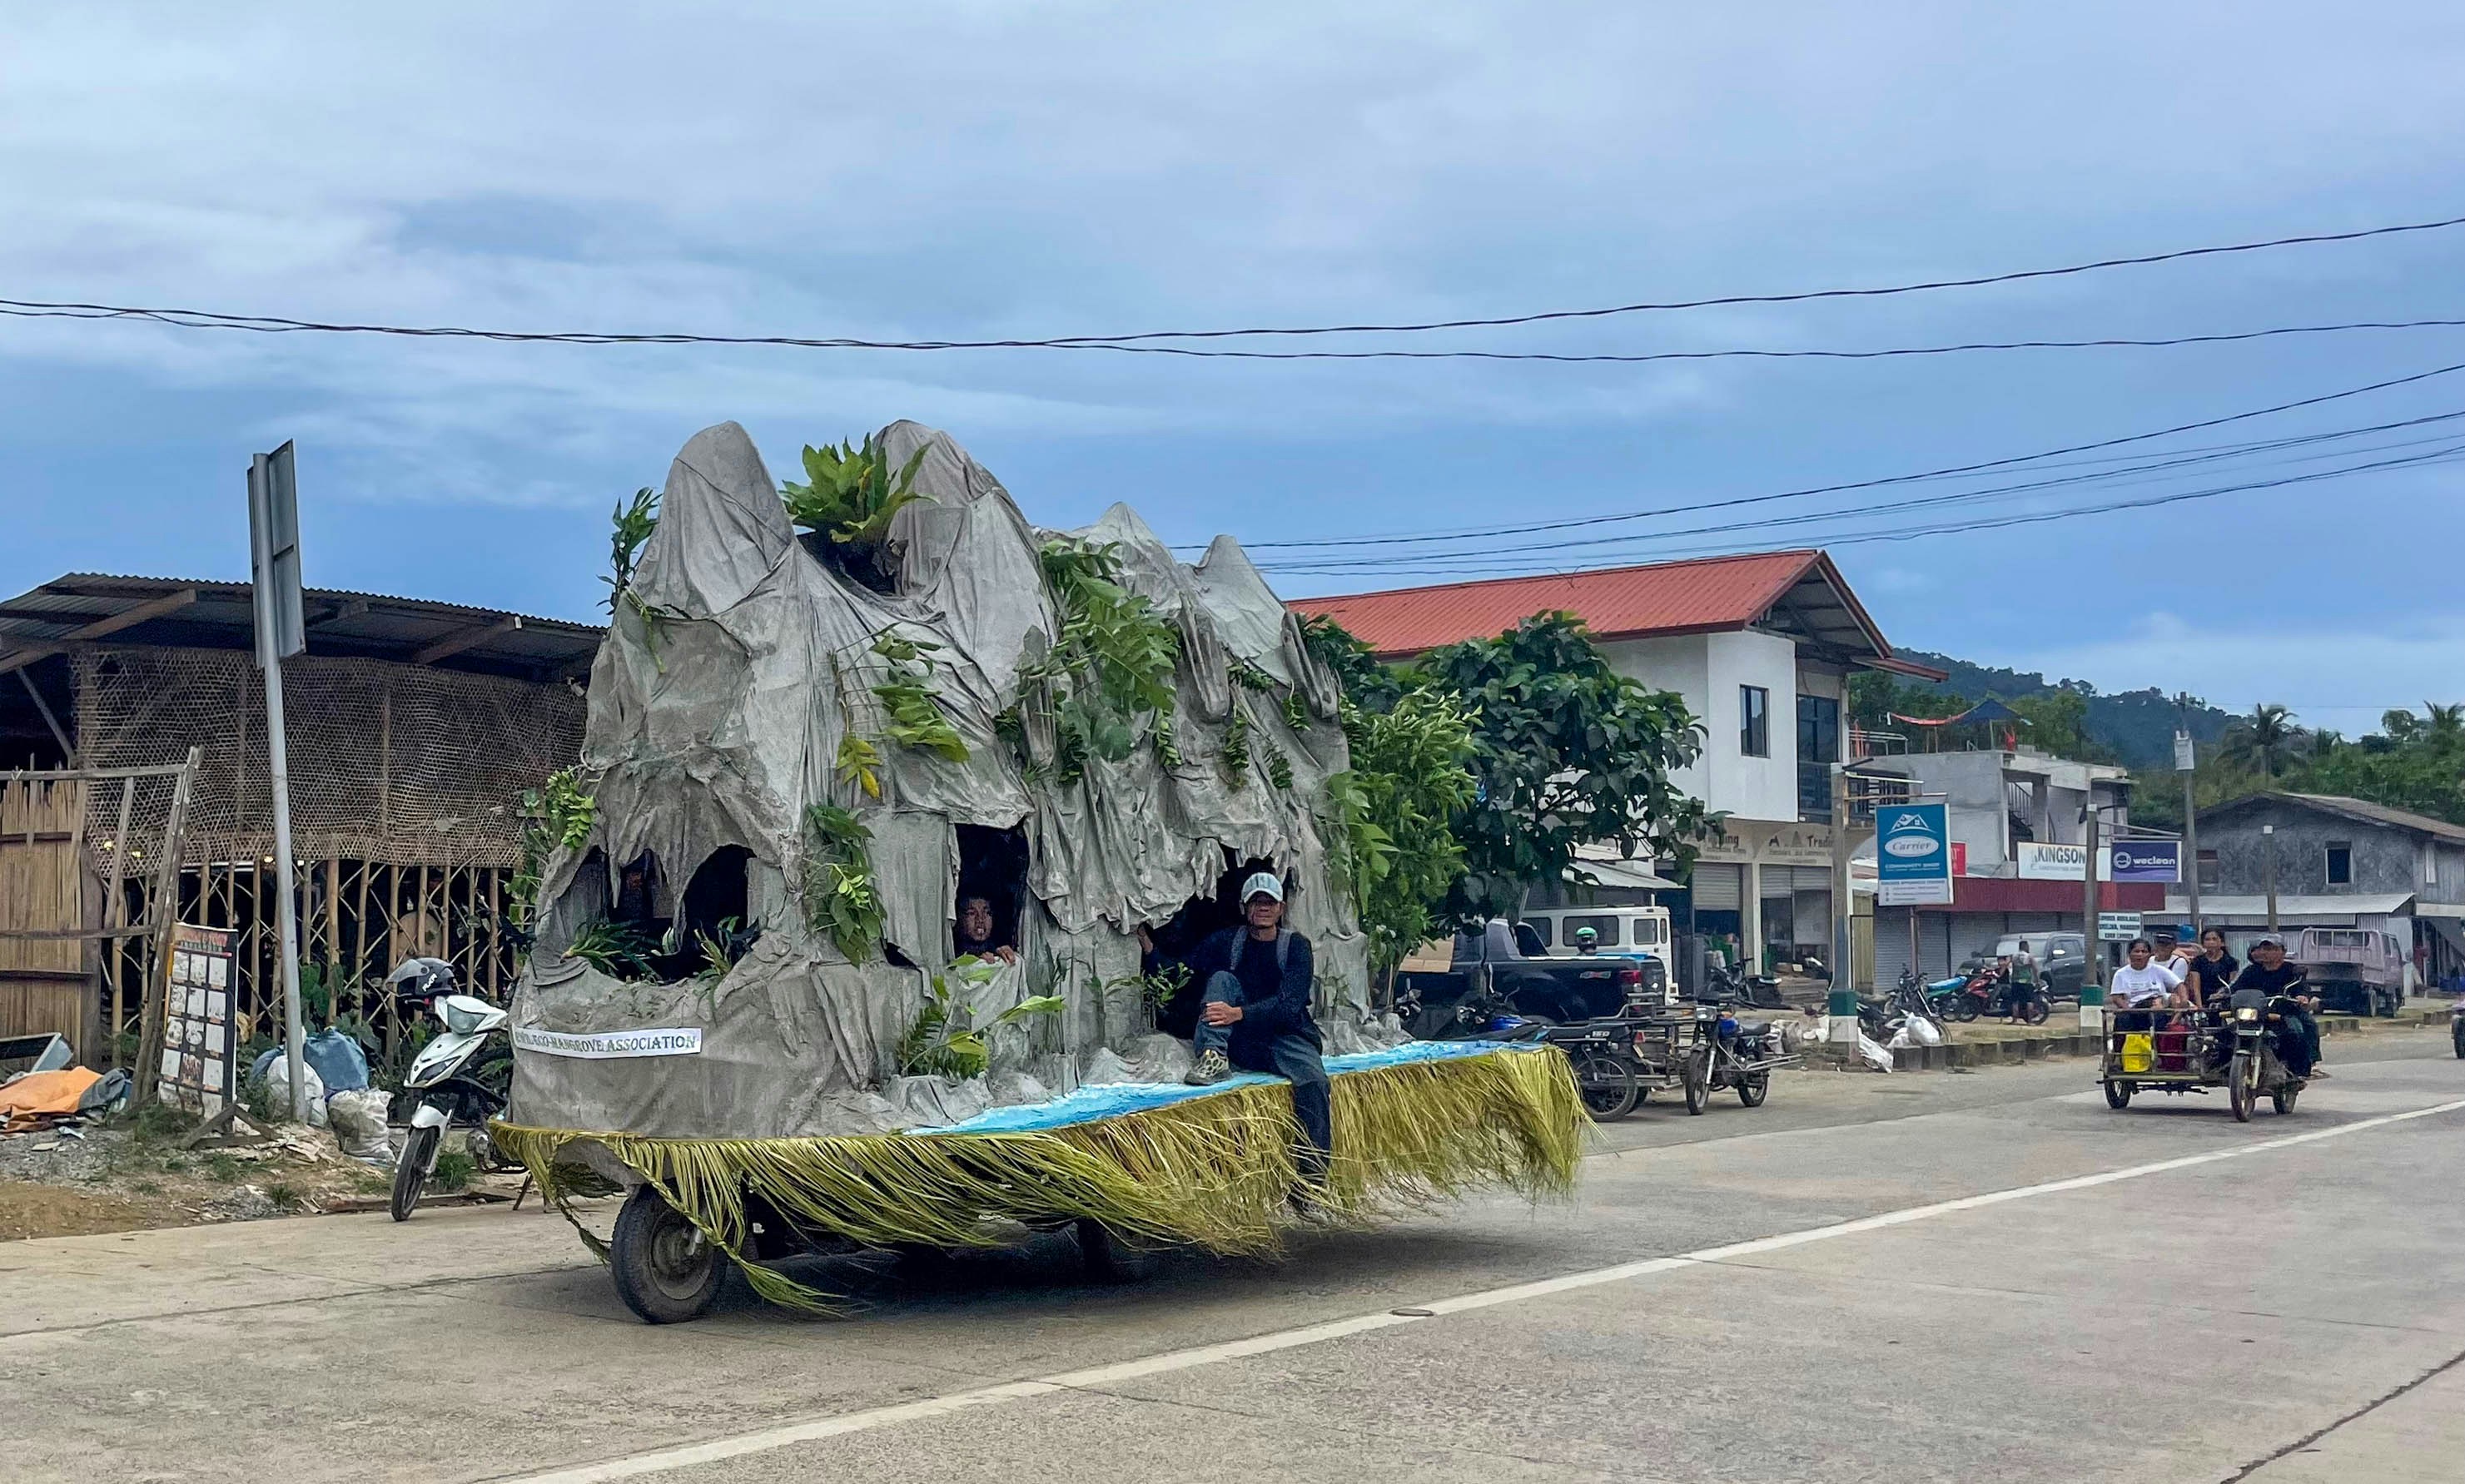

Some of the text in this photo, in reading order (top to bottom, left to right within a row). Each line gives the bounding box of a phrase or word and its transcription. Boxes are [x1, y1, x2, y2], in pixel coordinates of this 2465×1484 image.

[1892, 841, 1931, 851] Carrier
[2037, 845, 2085, 864] KINGSON
[2133, 856, 2176, 865] weclean
[607, 1035, 696, 1052] ASSOCIATION
